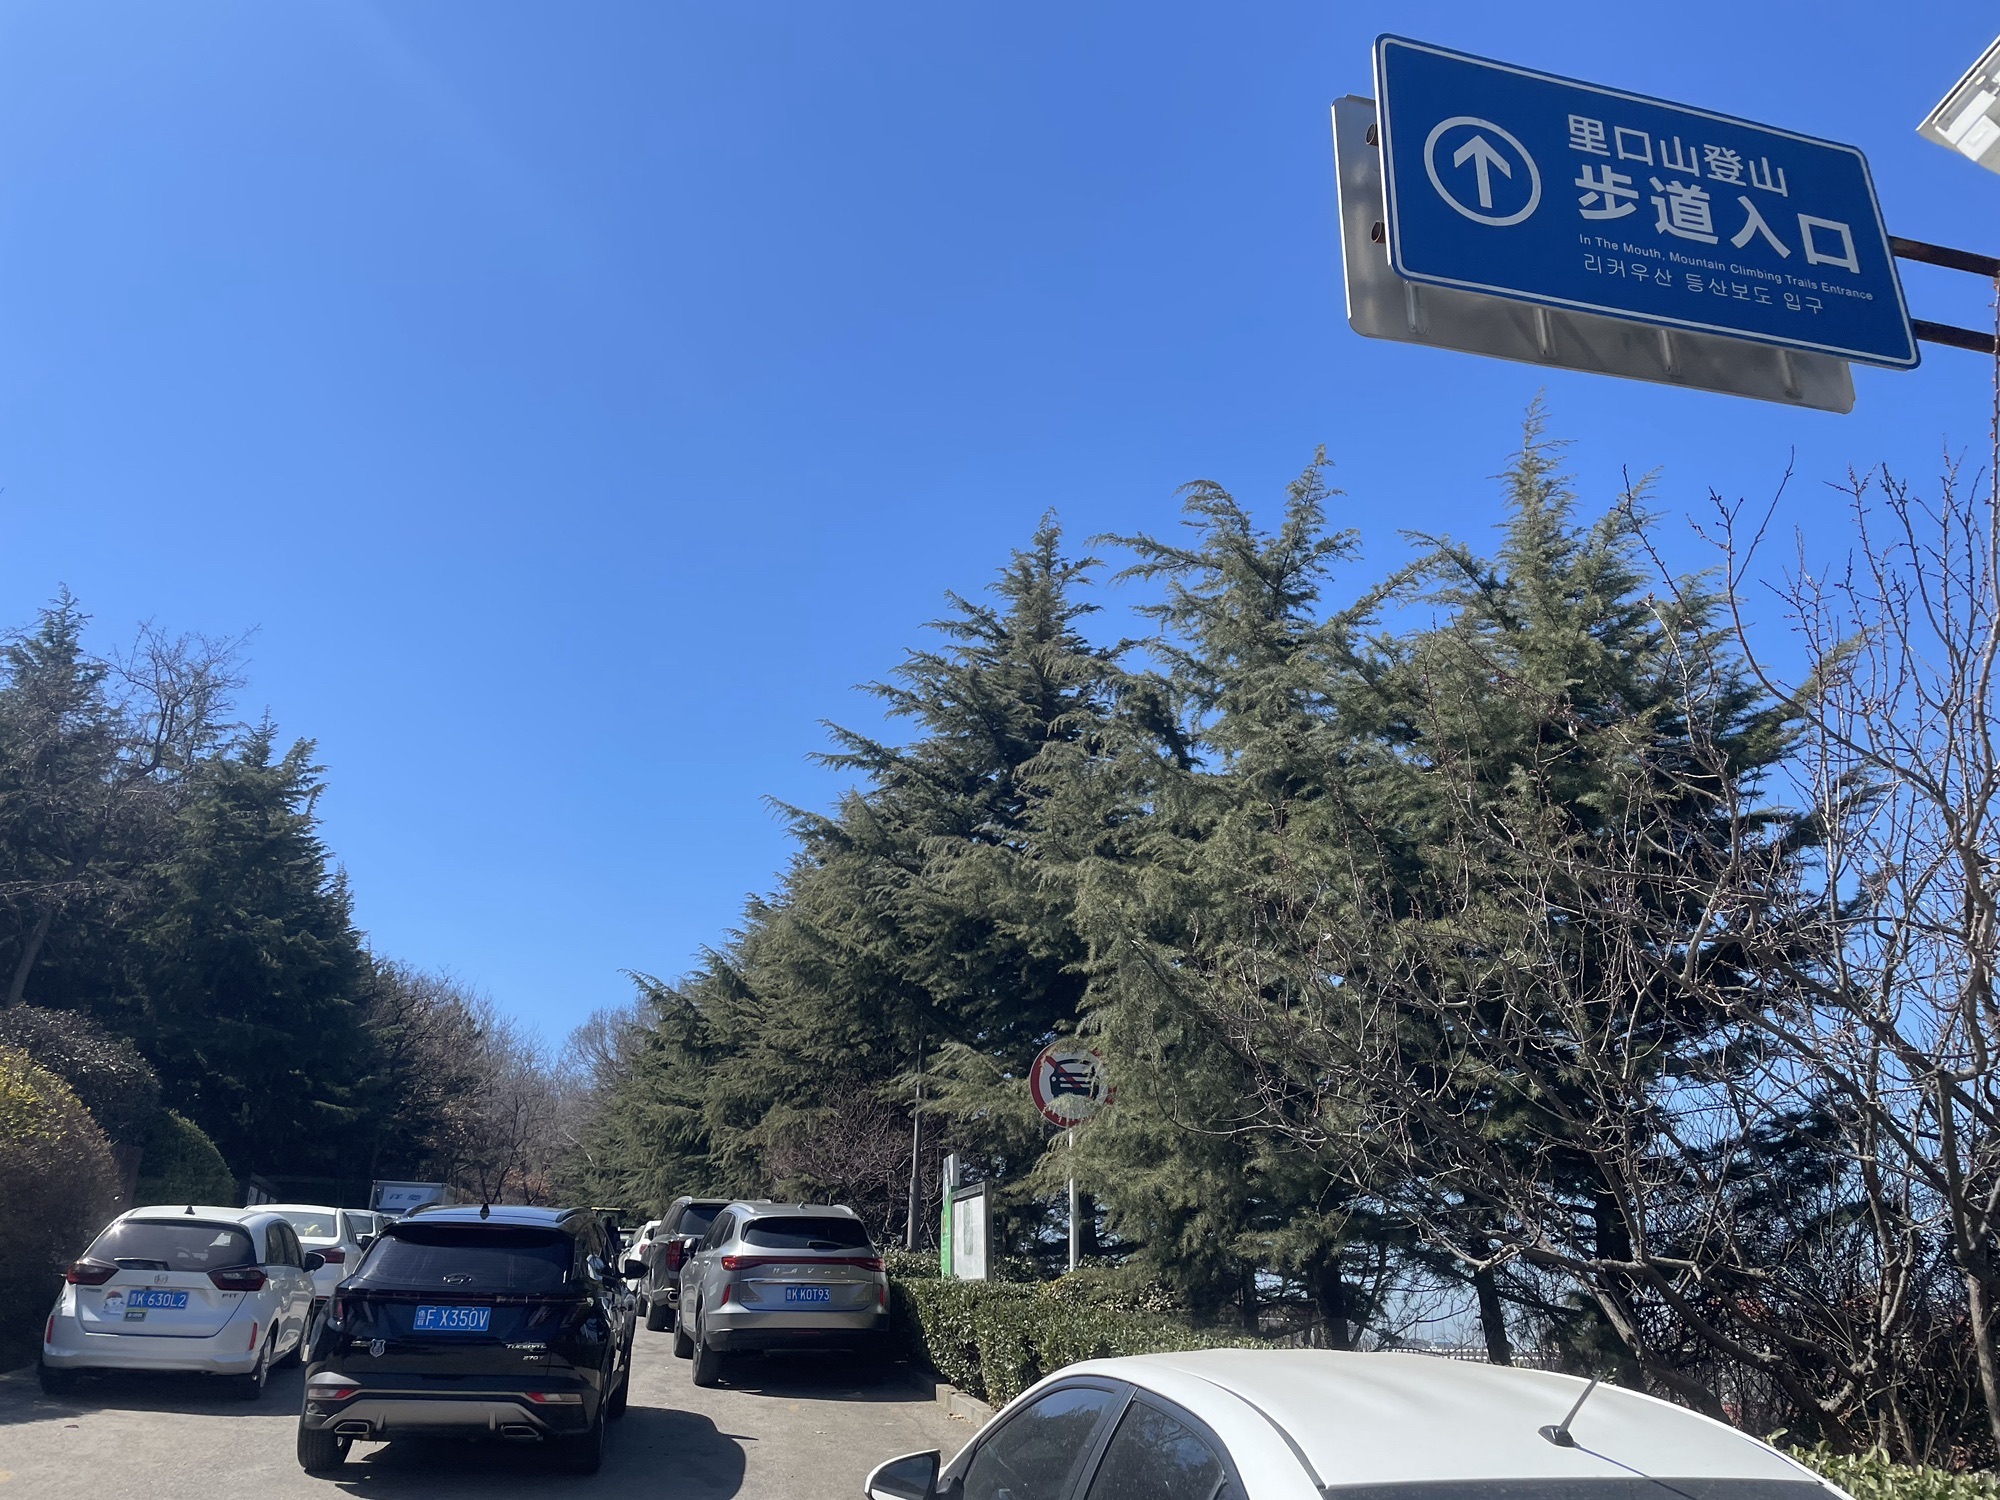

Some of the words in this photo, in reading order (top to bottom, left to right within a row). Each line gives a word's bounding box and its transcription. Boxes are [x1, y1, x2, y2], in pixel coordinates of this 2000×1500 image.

[1568, 114, 1788, 198] 里口山登山
[1574, 164, 1860, 274] 步道入口
[1580, 233, 1591, 245] In
[1595, 236, 1619, 251] The
[1669, 251, 1726, 271] Mountain
[1730, 263, 1783, 285] Climbing
[1785, 274, 1818, 290] Trails
[1821, 281, 1874, 301] Entrance
[1583, 253, 1673, 287] 리커우산
[1685, 272, 1773, 305] 등산보도
[1783, 292, 1824, 315] 입구
